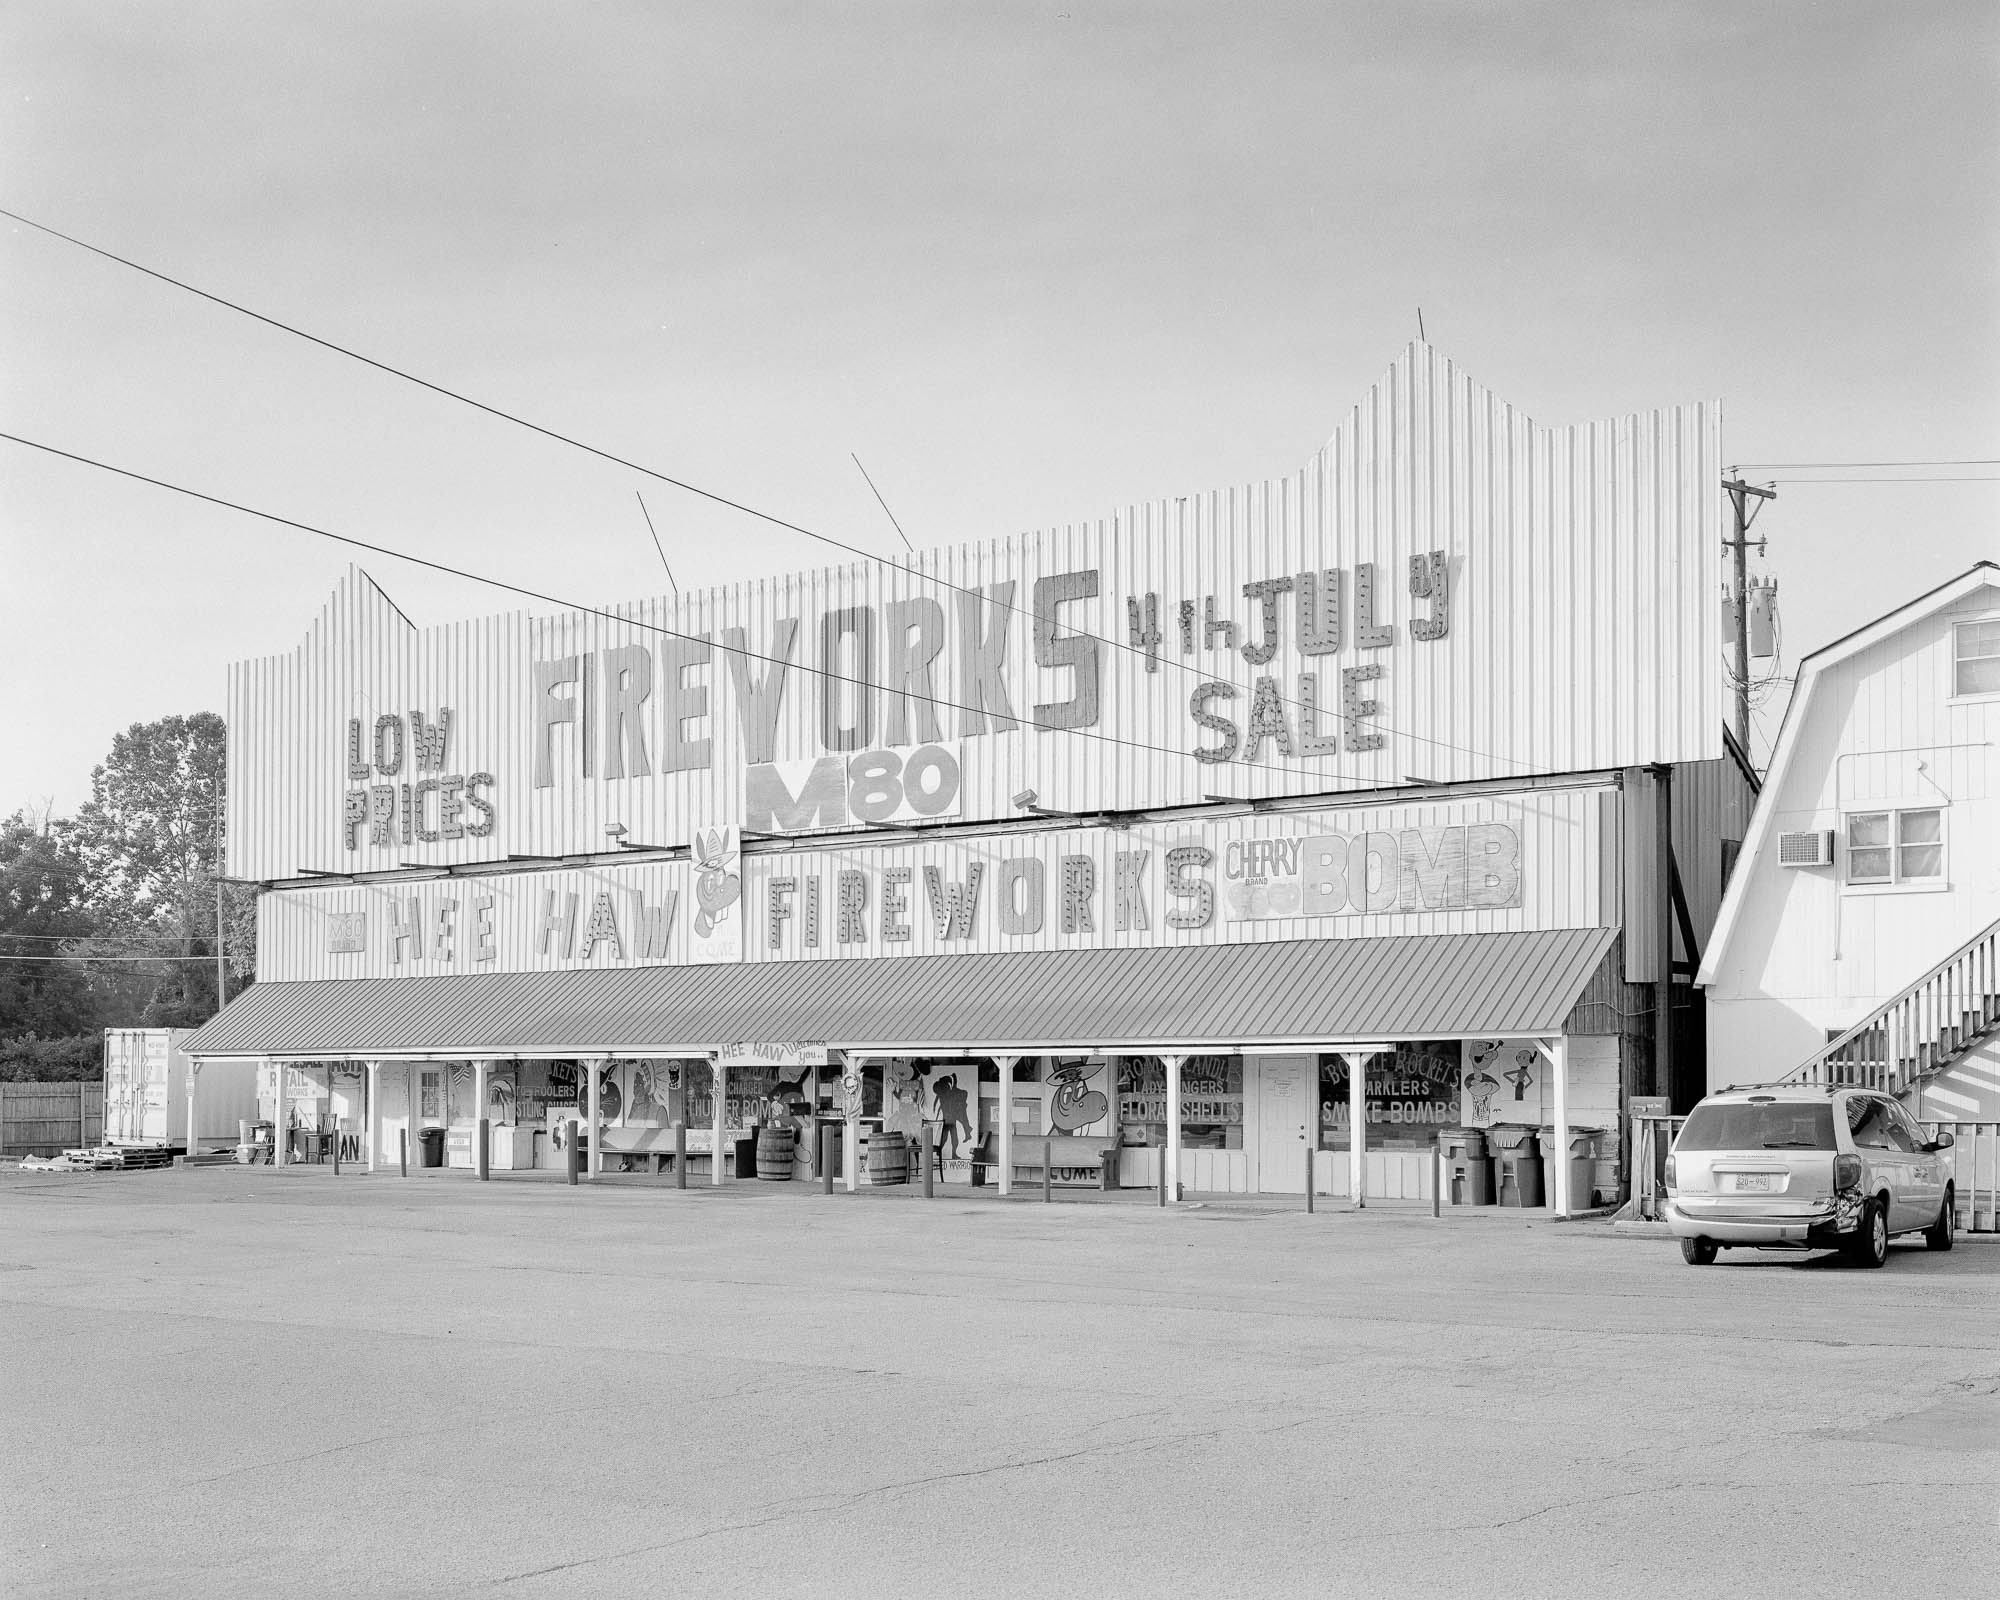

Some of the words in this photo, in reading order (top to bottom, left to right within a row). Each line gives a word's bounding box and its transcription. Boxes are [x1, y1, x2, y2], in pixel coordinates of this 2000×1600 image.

[1240, 550, 1449, 666] JULY
[533, 569, 1098, 789] FIREWORKS
[1189, 663, 1384, 765] SALE
[347, 706, 450, 780] LOW
[745, 744, 961, 833] M80
[344, 771, 495, 851] PRICES
[1225, 837, 1304, 881] CHERRY
[1303, 823, 1520, 915] BOMB
[1245, 877, 1269, 886] BRAND
[386, 893, 498, 964] HEE
[536, 888, 681, 960] HAW
[767, 845, 1215, 950] FIREWORKS
[721, 1041, 745, 1060] HEE
[752, 1041, 785, 1062] HAW
[1324, 1052, 1388, 1086] BOLE
[1395, 1050, 1462, 1088] ROCKETS
[1182, 1080, 1225, 1095] NGERS
[1364, 1080, 1430, 1096] ARKLERS
[516, 1100, 544, 1118] STLING
[687, 1098, 740, 1118] THUER
[743, 1099, 773, 1119] BOM
[1119, 1100, 1168, 1121] FLORA
[1181, 1100, 1240, 1122] SHELLS
[1322, 1100, 1384, 1124] SMKE
[1390, 1100, 1461, 1124] BOMBS
[339, 1134, 360, 1161] AN
